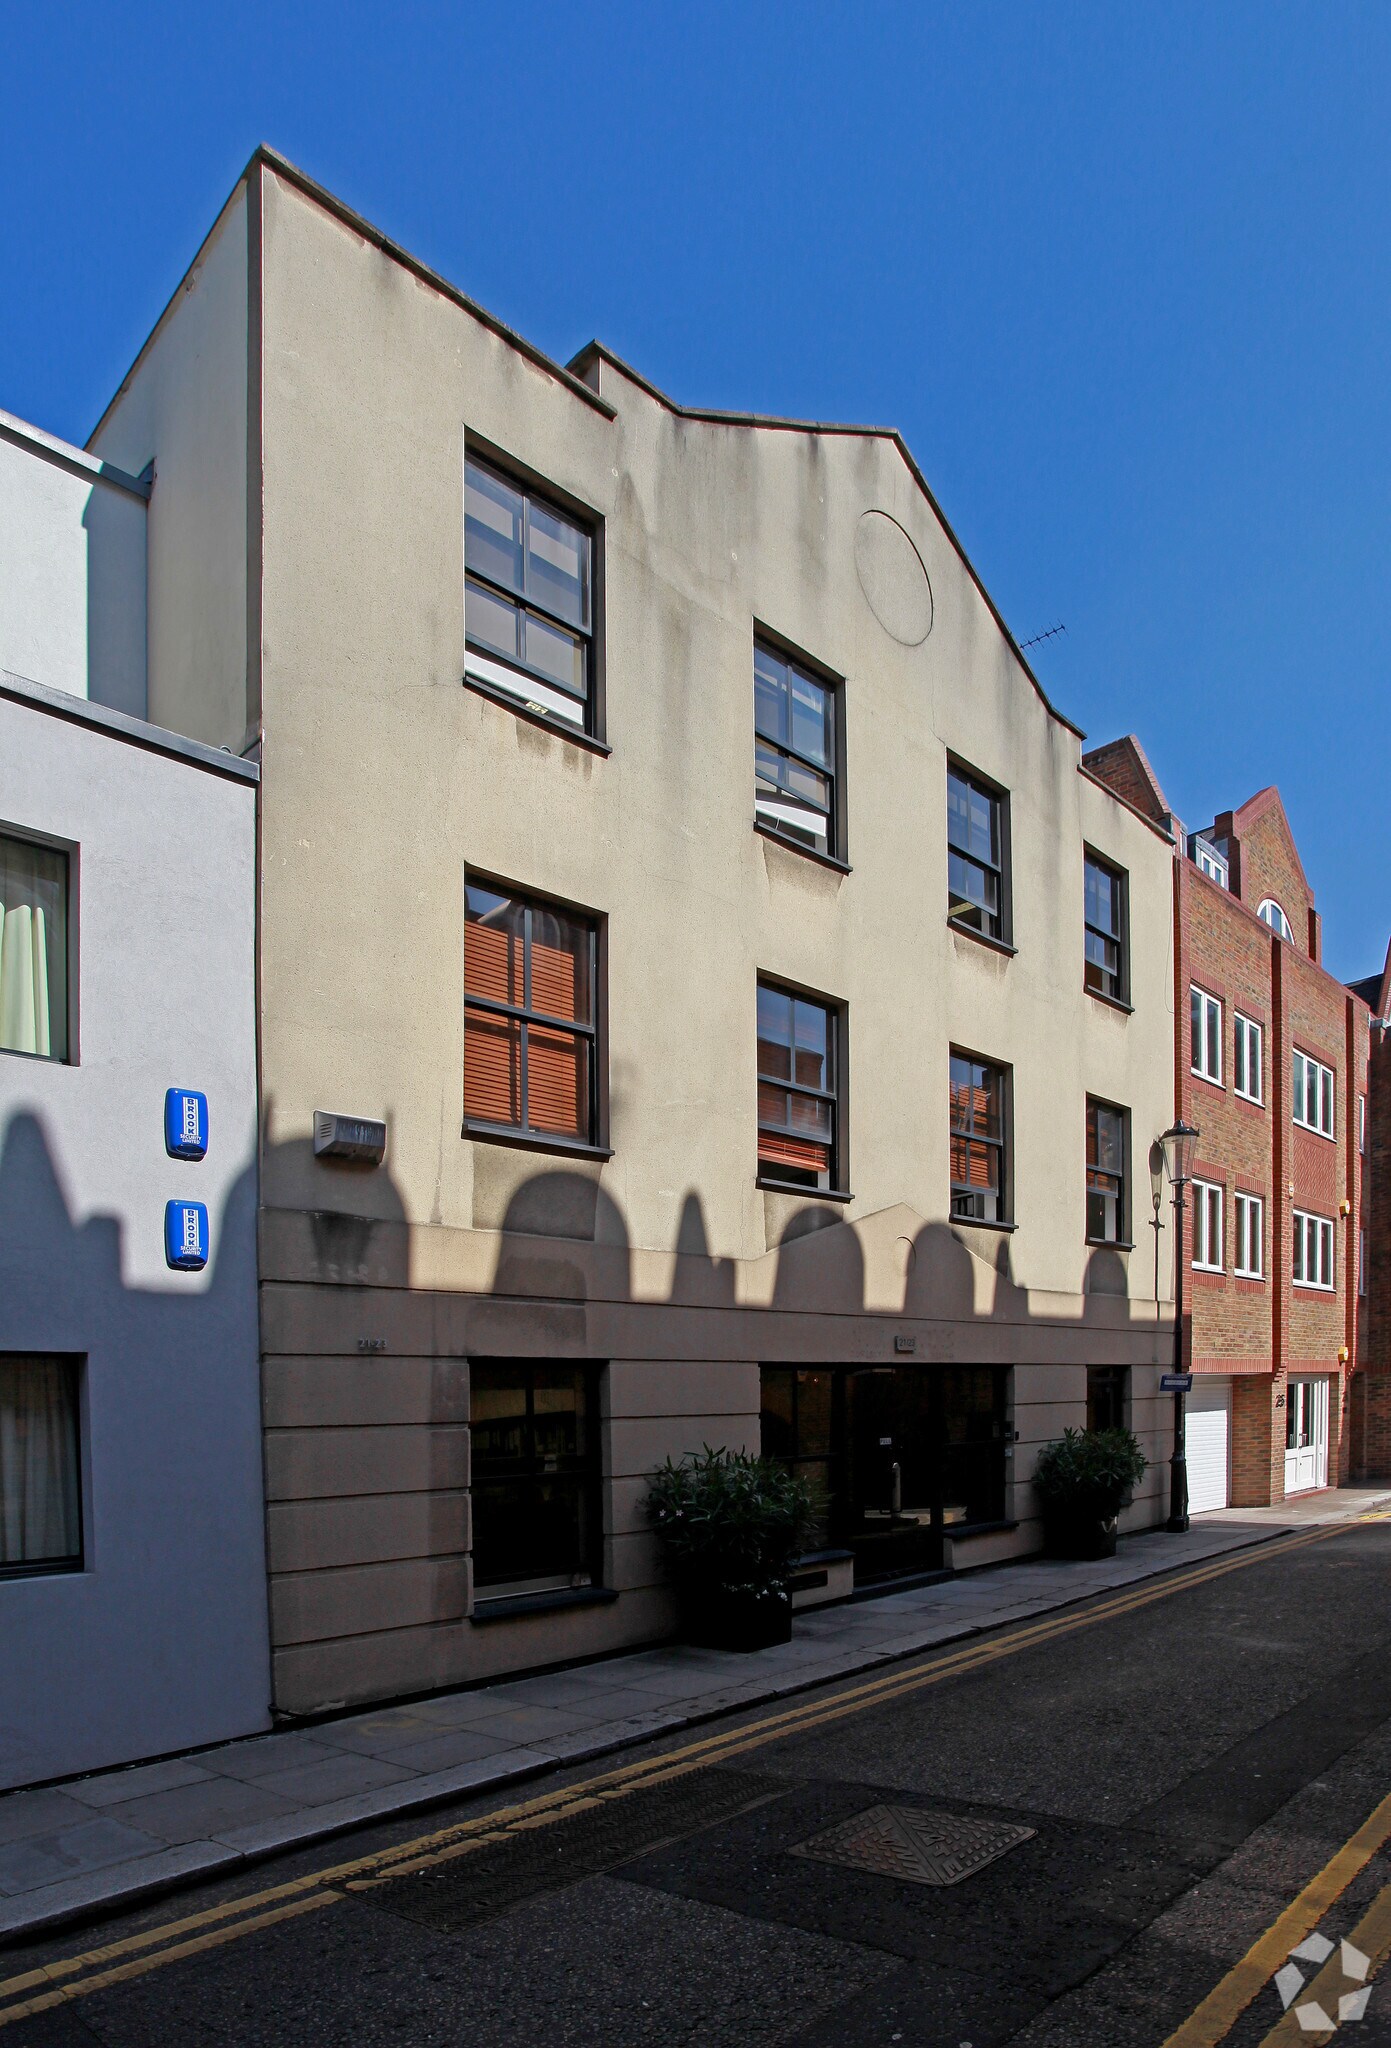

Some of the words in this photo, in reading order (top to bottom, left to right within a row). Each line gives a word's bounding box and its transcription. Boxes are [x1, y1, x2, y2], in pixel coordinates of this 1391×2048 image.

[187, 1098, 195, 1135] BROOK
[180, 1133, 202, 1141] SECURITY
[187, 1209, 195, 1246] BROOK
[1275, 1394, 1285, 1408] 25
